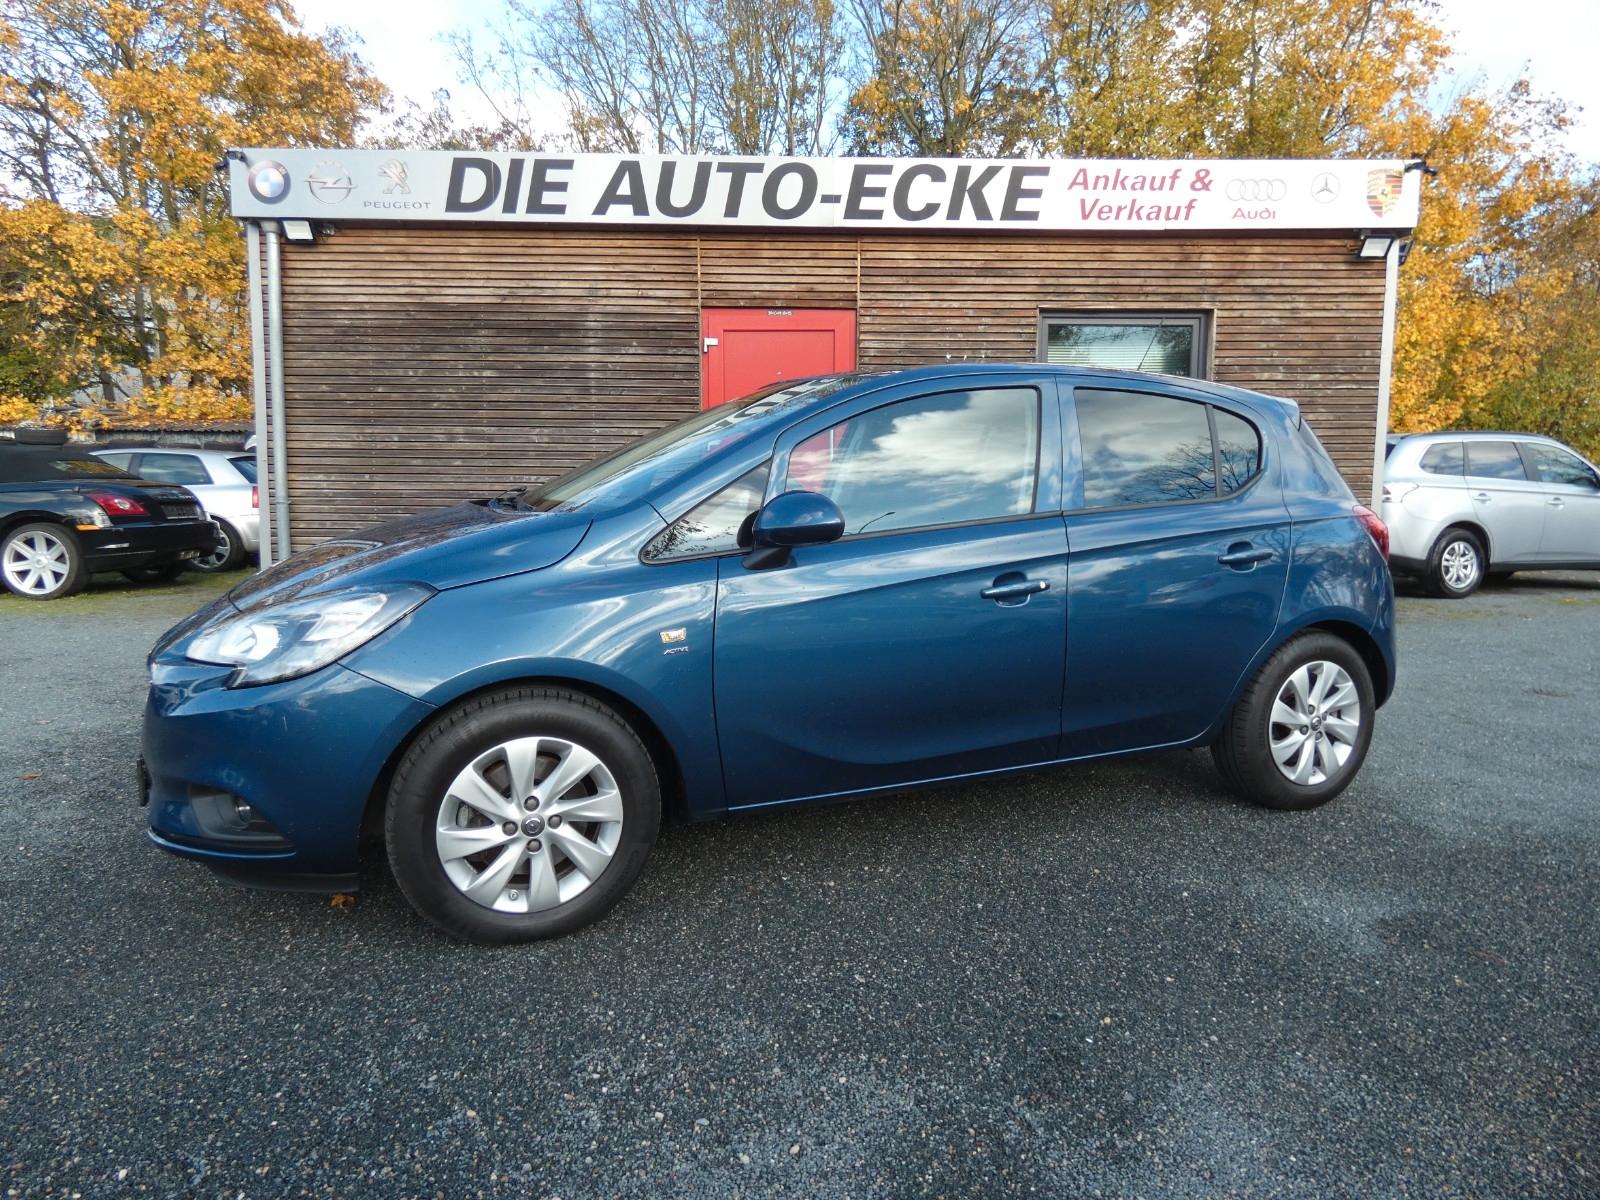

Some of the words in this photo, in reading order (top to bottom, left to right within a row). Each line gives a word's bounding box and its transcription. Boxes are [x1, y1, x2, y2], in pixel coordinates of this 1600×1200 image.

[445, 157, 575, 215] DIE
[591, 160, 1050, 221] AUTO-ECKE
[1068, 168, 1182, 192] Ankauf
[1189, 168, 1213, 192] &
[363, 201, 431, 209] PEUGEOT
[1079, 198, 1198, 221] Verkauf
[1231, 207, 1276, 220] Audi
